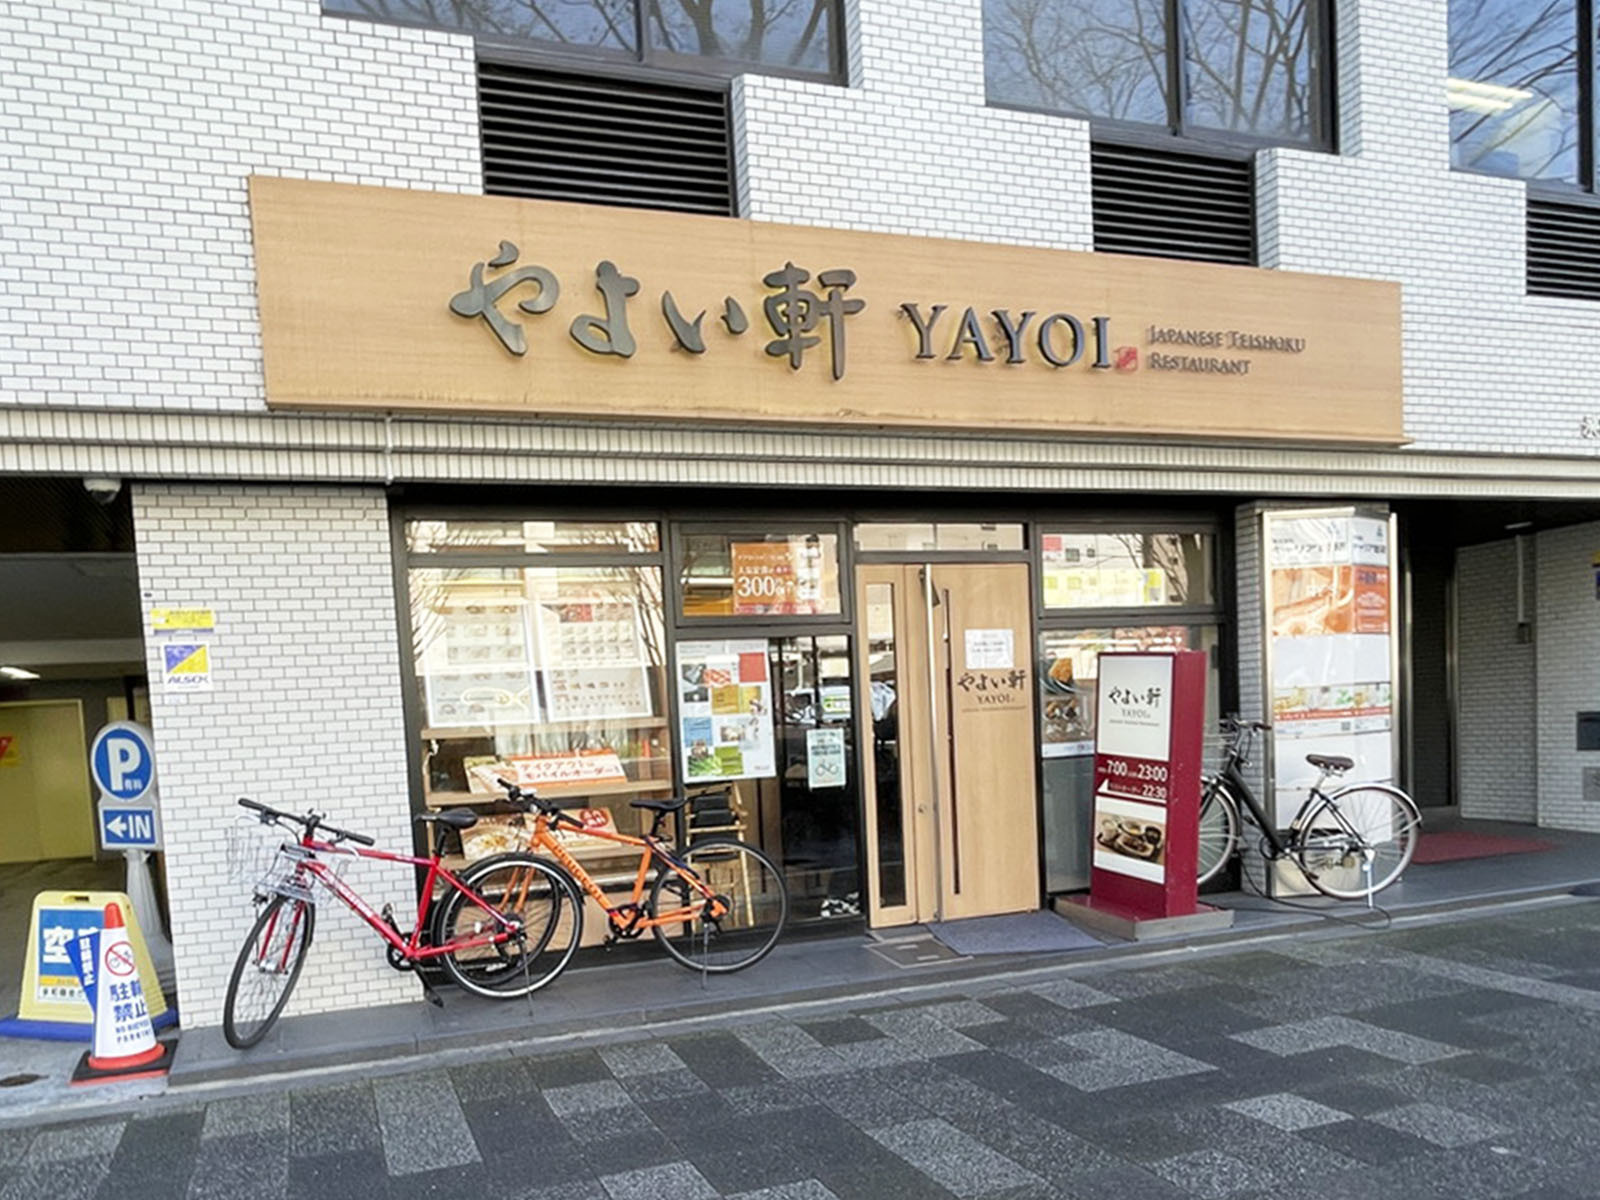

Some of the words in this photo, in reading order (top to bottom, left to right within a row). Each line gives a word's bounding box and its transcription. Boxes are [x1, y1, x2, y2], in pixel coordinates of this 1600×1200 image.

[449, 240, 866, 381] やよい軒
[899, 303, 1112, 371] YAYOI
[1149, 325, 1223, 348] JAPANESE
[1228, 331, 1306, 353] TEISHOKU
[1149, 352, 1251, 375] RESTAURANT
[737, 576, 775, 598] 300
[957, 669, 1026, 692] やよい軒
[976, 693, 1010, 704] YAYOI
[1108, 686, 1161, 708] やよい軒
[107, 738, 141, 791] P
[128, 815, 151, 839] IN
[114, 1001, 147, 1022] 禁止
